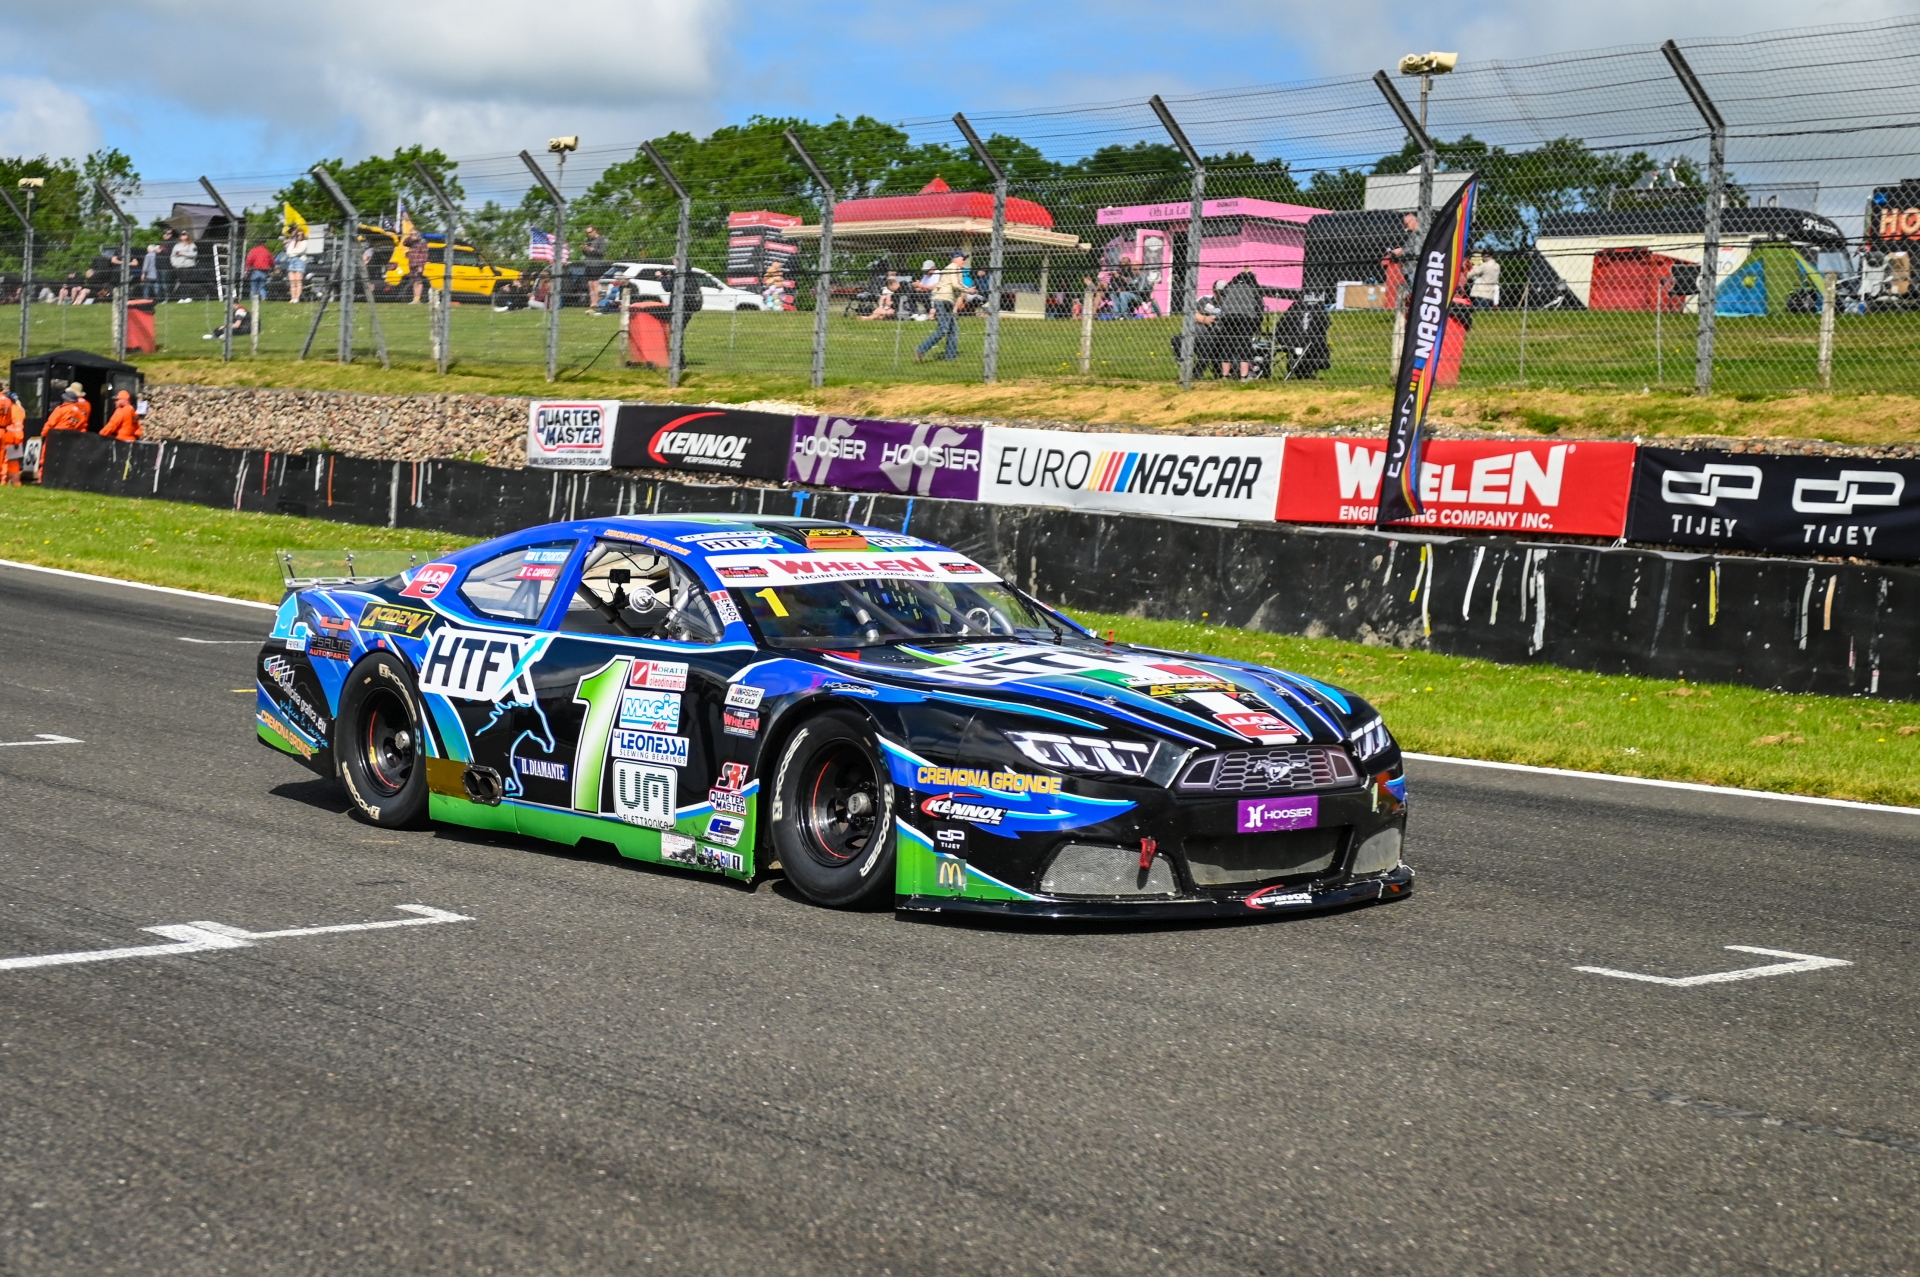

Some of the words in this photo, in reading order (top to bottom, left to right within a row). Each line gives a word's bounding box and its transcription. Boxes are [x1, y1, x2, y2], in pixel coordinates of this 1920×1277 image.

[1415, 250, 1446, 360] NASCAR
[537, 409, 601, 434] QUARTER
[544, 426, 602, 446] MASTER
[653, 431, 748, 460] KENNOL
[1387, 393, 1414, 478] EURO
[794, 435, 867, 462] HOOSIER
[881, 441, 981, 472] HOOSIER
[682, 455, 729, 466] PERFORMANCE
[729, 460, 742, 468] OIL
[996, 446, 1092, 491] EURO
[1127, 452, 1264, 500] NASCAR
[1334, 440, 1569, 507] WELEN
[1440, 507, 1517, 527] COMPANY
[1520, 510, 1554, 529] INC.
[1671, 515, 1737, 538] TIJEY
[1803, 524, 1878, 547] TIJEY
[768, 556, 937, 574] WHELEN
[793, 571, 868, 581] ENGINEERING
[415, 570, 450, 584] ALCO
[721, 599, 740, 621] ENEOS
[755, 587, 790, 617] 1
[360, 606, 431, 633] ACADEMY
[309, 648, 327, 657] AUTO
[328, 650, 350, 660] PARTS
[424, 634, 550, 697] HTFX
[651, 663, 687, 675] MORATTI
[649, 678, 686, 689] oleodinamica
[822, 681, 880, 697] HOOSIER
[651, 720, 668, 731] PACK
[723, 711, 760, 731] WHELEN
[1227, 715, 1280, 726] ALCO
[261, 709, 289, 742] CREMONA
[289, 731, 313, 761] GRONDE
[573, 655, 634, 814] 1
[620, 732, 687, 757] LEONESSA
[619, 748, 650, 760] SLEWING
[652, 753, 687, 764] BEARINGS
[774, 728, 810, 802] HOOSIER
[522, 758, 530, 774] IL
[529, 759, 566, 781] DIAMANTE
[917, 766, 990, 788] CREMONA
[991, 771, 1063, 795] GRONDE
[342, 760, 371, 815] HOOSIER
[619, 768, 670, 815] UM
[710, 790, 744, 805] QUARTER
[715, 800, 746, 814] MASTER
[926, 799, 1003, 821] KENNOL
[1264, 808, 1313, 820] HOOSIER
[859, 803, 892, 877] HOOSIER
[1250, 892, 1313, 905] KENNOL
